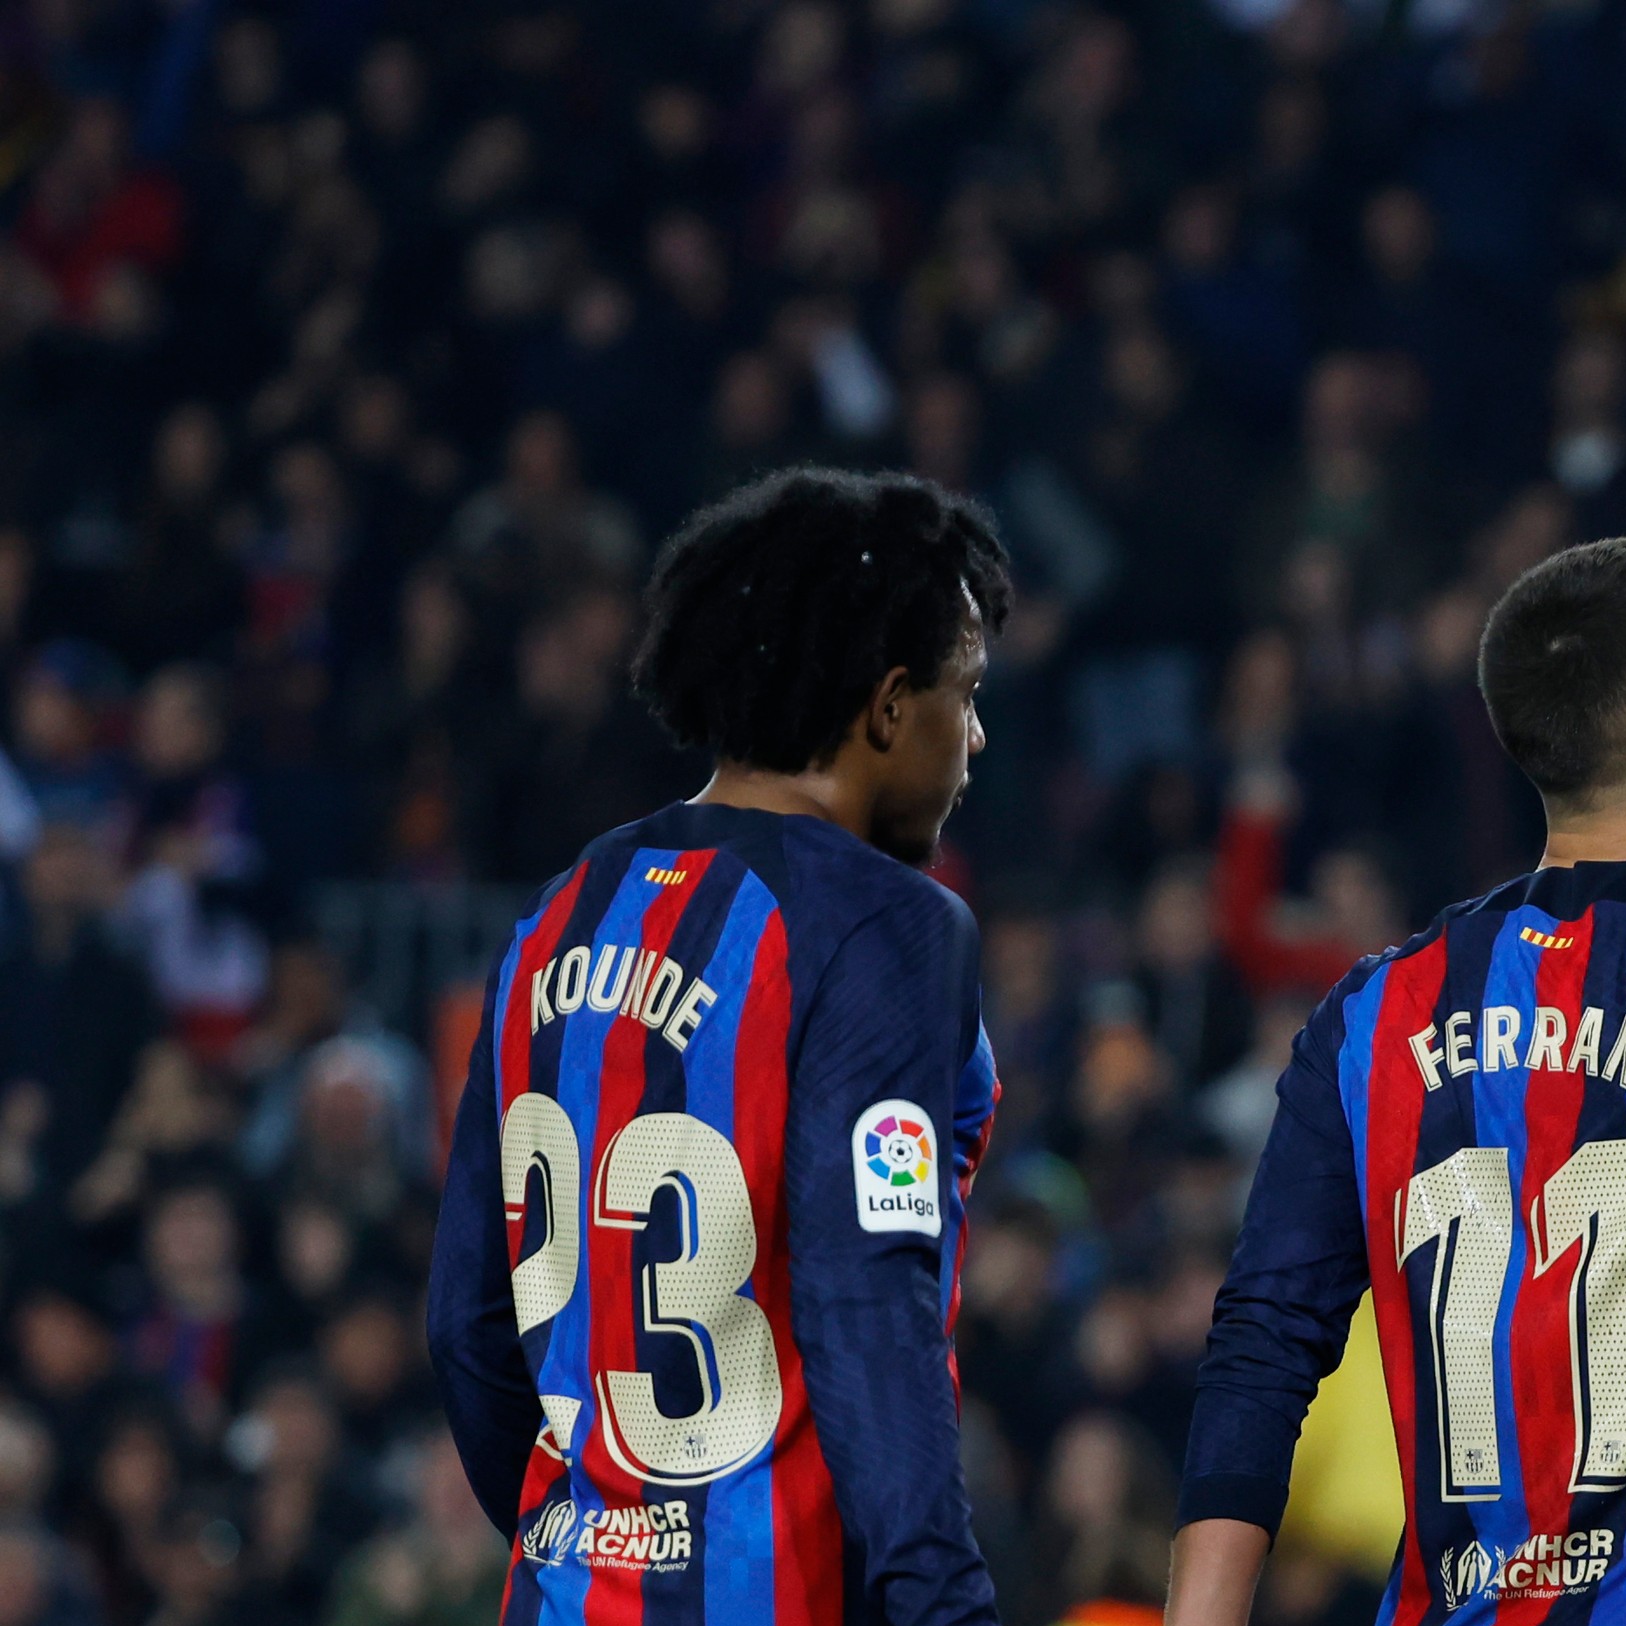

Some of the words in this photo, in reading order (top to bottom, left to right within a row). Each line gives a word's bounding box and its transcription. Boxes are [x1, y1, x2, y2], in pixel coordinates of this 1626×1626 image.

[530, 944, 718, 1052] KOUNDE
[868, 1192, 935, 1217] LaLiga
[500, 1091, 782, 1487] 23
[583, 1499, 691, 1536] UNHCR
[574, 1528, 692, 1562] ACNUR
[592, 1556, 606, 1567] UN
[606, 1556, 652, 1571] Refugee
[652, 1559, 690, 1574] Agency
[1505, 1588, 1522, 1600] UN
[1524, 1586, 1565, 1600] Refugee
